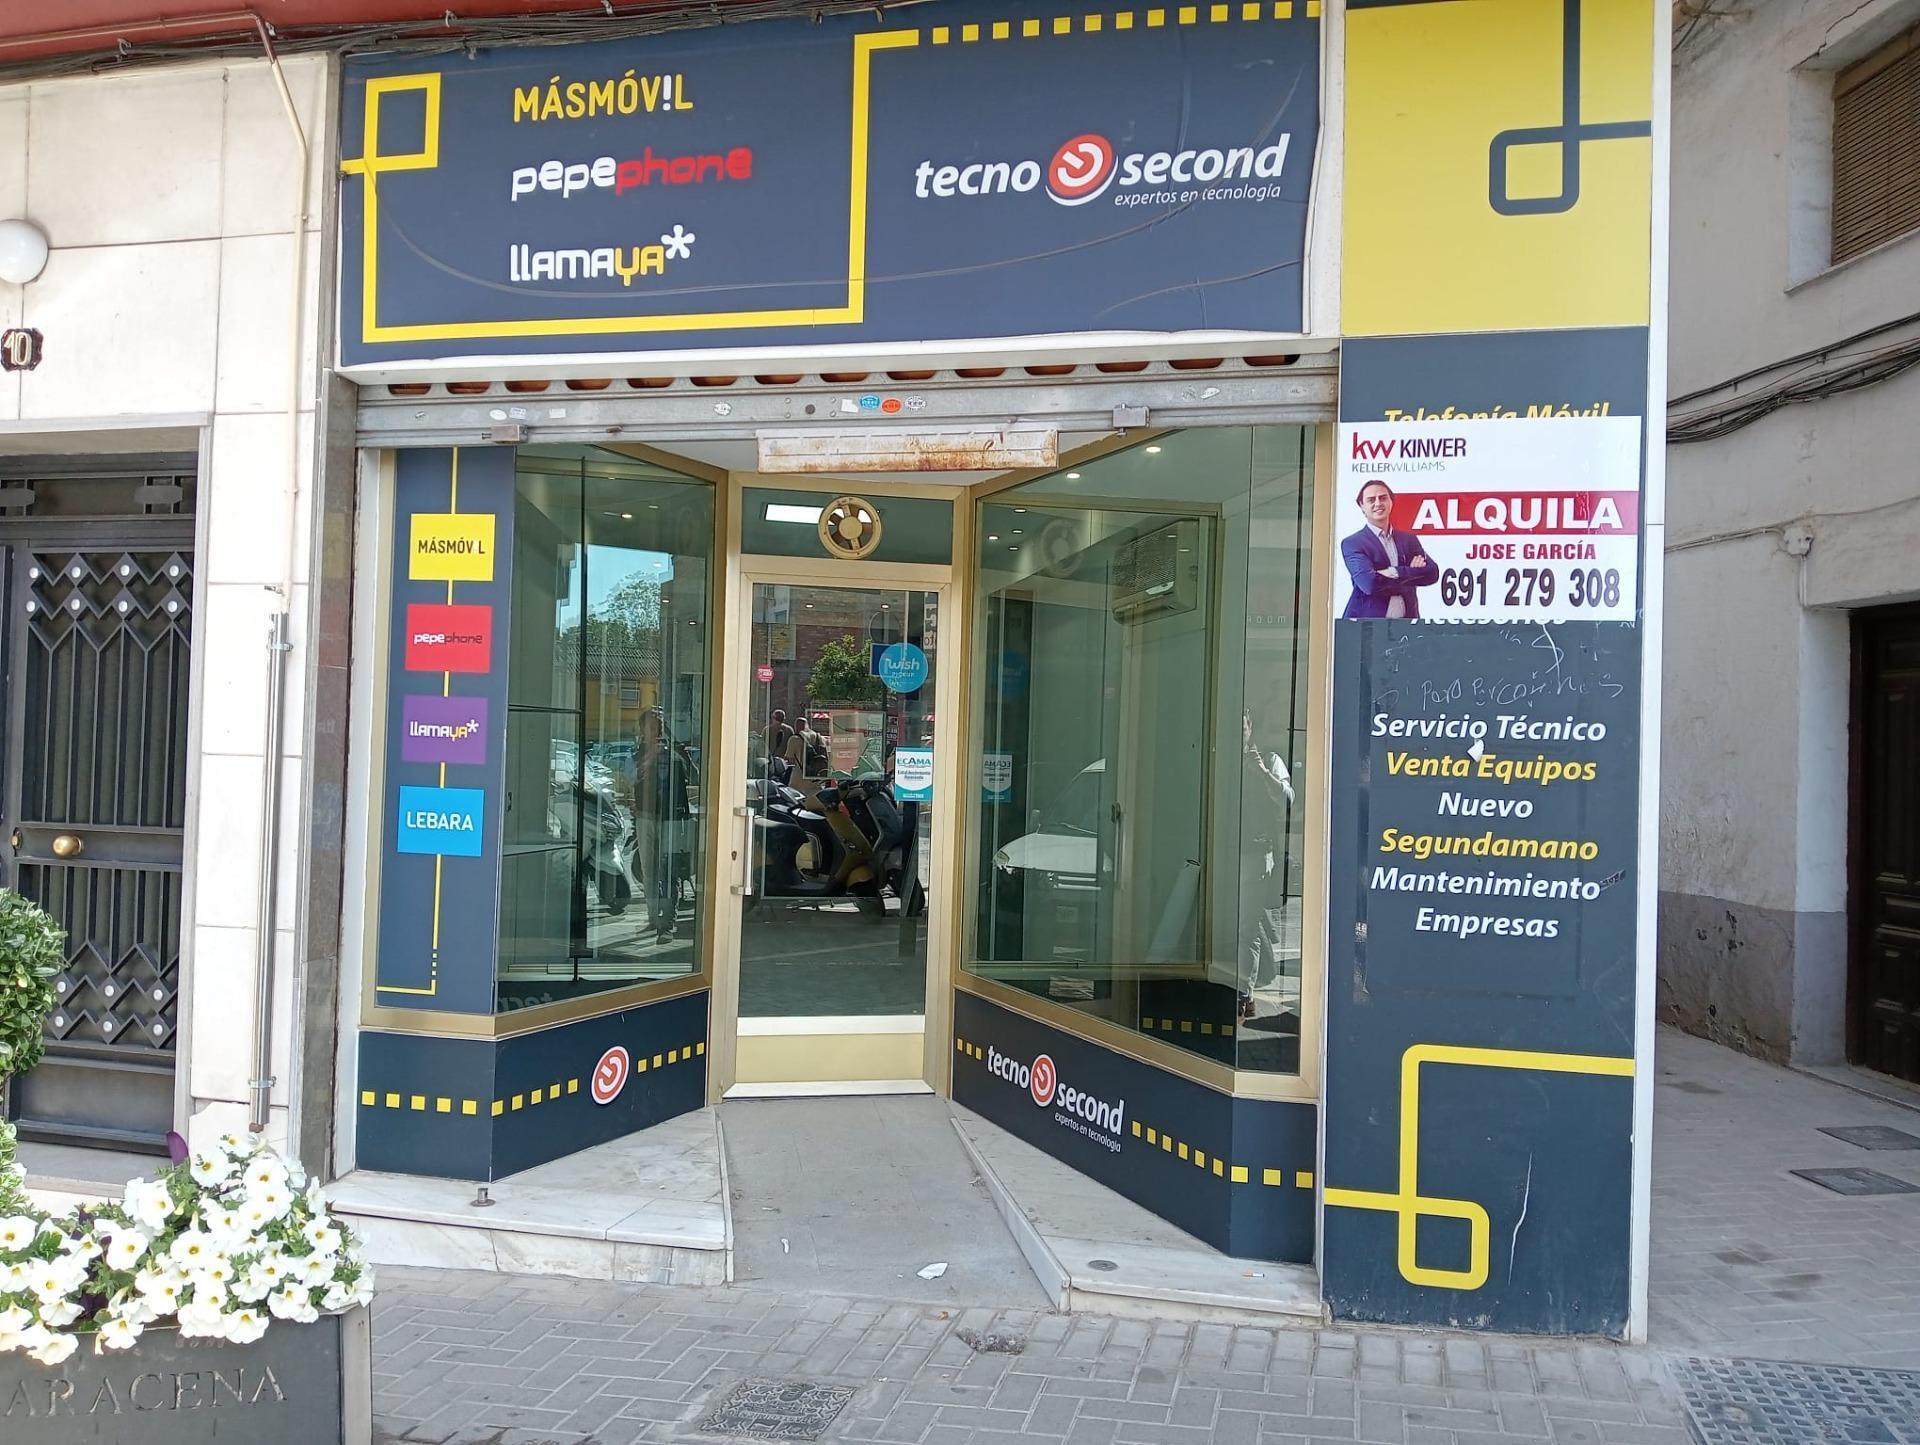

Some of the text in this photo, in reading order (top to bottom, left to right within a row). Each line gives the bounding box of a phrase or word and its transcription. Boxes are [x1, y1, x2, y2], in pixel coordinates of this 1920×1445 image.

[511, 146, 752, 201] pepephone
[915, 133, 1290, 198] tecno second
[1114, 190, 1177, 208] expertos
[1202, 184, 1281, 202] tecnología
[4, 332, 32, 366] 10
[1400, 437, 1467, 458] KINVER
[1411, 497, 1623, 532] ALQUILA
[1466, 540, 1596, 560] JOSE GARCÍA
[1441, 568, 1620, 607] 691 279 308
[1371, 713, 1607, 741] Servicio Técnico
[1387, 752, 1597, 785] Venta Equipos
[406, 811, 474, 832] LEBARA
[1437, 792, 1534, 818] Nuevo
[1380, 828, 1599, 860] Segundamano
[1370, 866, 1601, 901] Mantenimiento
[1415, 907, 1559, 939] Empresas
[987, 1045, 1125, 1136] tecno second
[3, 1366, 288, 1417] ARACENA
